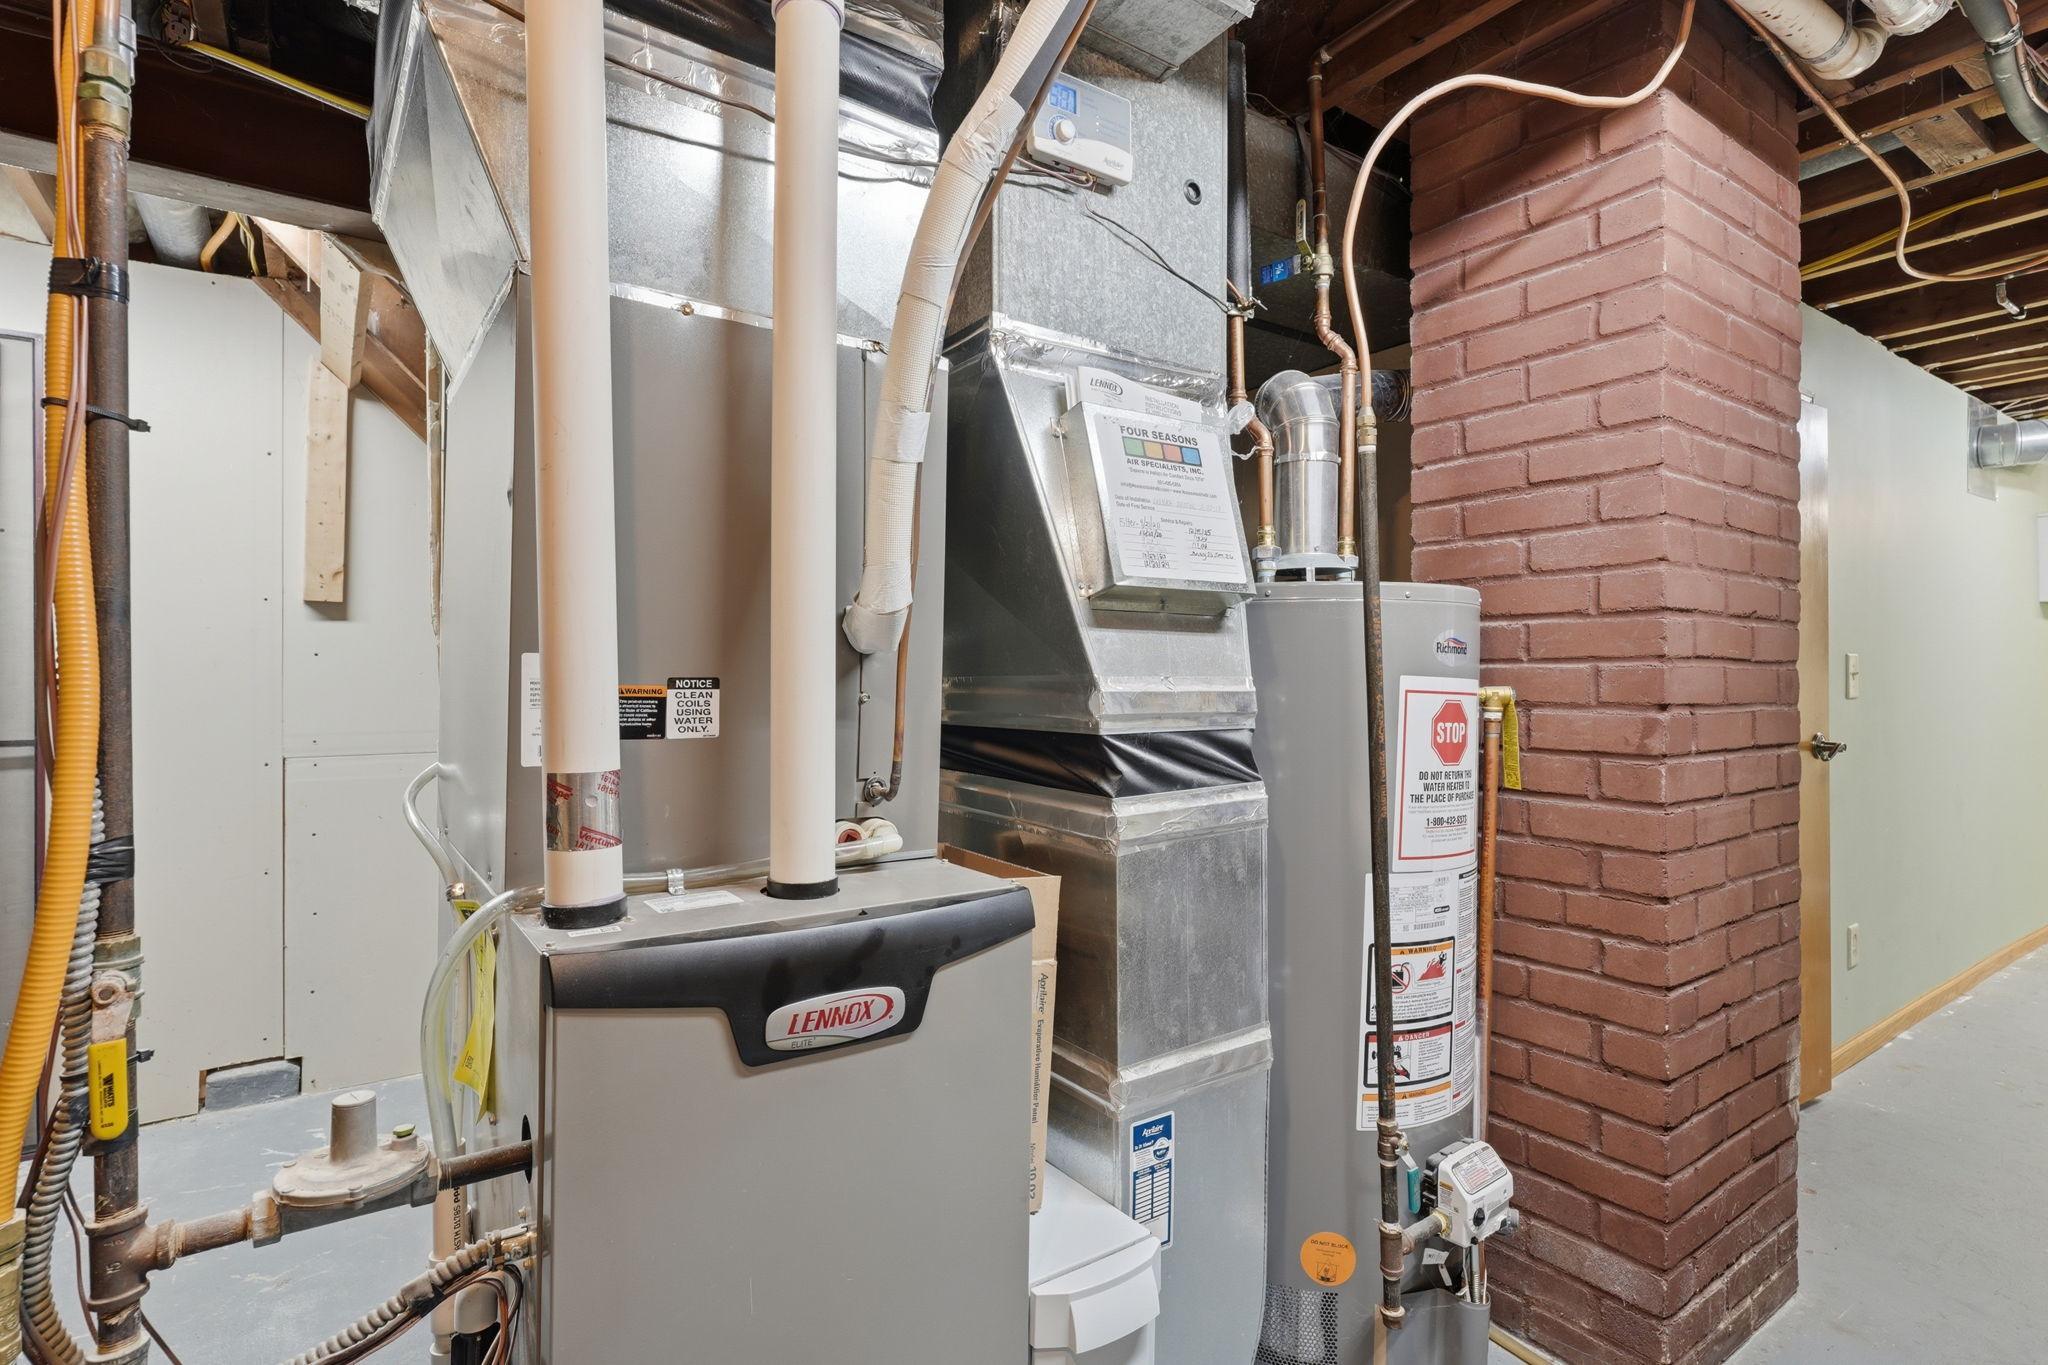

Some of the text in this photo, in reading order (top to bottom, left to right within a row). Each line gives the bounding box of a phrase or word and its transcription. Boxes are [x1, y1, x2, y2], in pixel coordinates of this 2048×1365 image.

[1090, 378, 1118, 393] LENNOX
[1119, 425, 1198, 446] FOUR SEASONS
[1126, 458, 1140, 466] AIR
[1140, 459, 1189, 474] SPECIALISTS,
[1189, 467, 1204, 476] INC.
[1436, 641, 1468, 655] Richmond
[675, 679, 713, 688] NOTICE
[675, 691, 713, 699] CLEAN
[676, 708, 711, 716] USING
[677, 725, 709, 733] ONLY.
[1436, 722, 1466, 744] STOP
[1419, 771, 1429, 780] DO
[1430, 771, 1443, 780] NOT
[1444, 770, 1463, 780] RETURN
[1423, 782, 1445, 792] WATER
[1446, 781, 1464, 791] HEATER
[1410, 794, 1424, 803] THE
[1426, 793, 1446, 803] PLACE
[1447, 792, 1455, 802] OF
[1408, 946, 1438, 954] WARNING
[1037, 973, 1049, 1013] Aprilaire
[787, 1000, 876, 1035] LENNOX
[1036, 1019, 1044, 1061] Evaporative
[1404, 1032, 1430, 1041] DANGER
[791, 1038, 814, 1049] ELITE
[1032, 1063, 1042, 1101] Humidifier
[453, 1230, 461, 1250] ASTM
